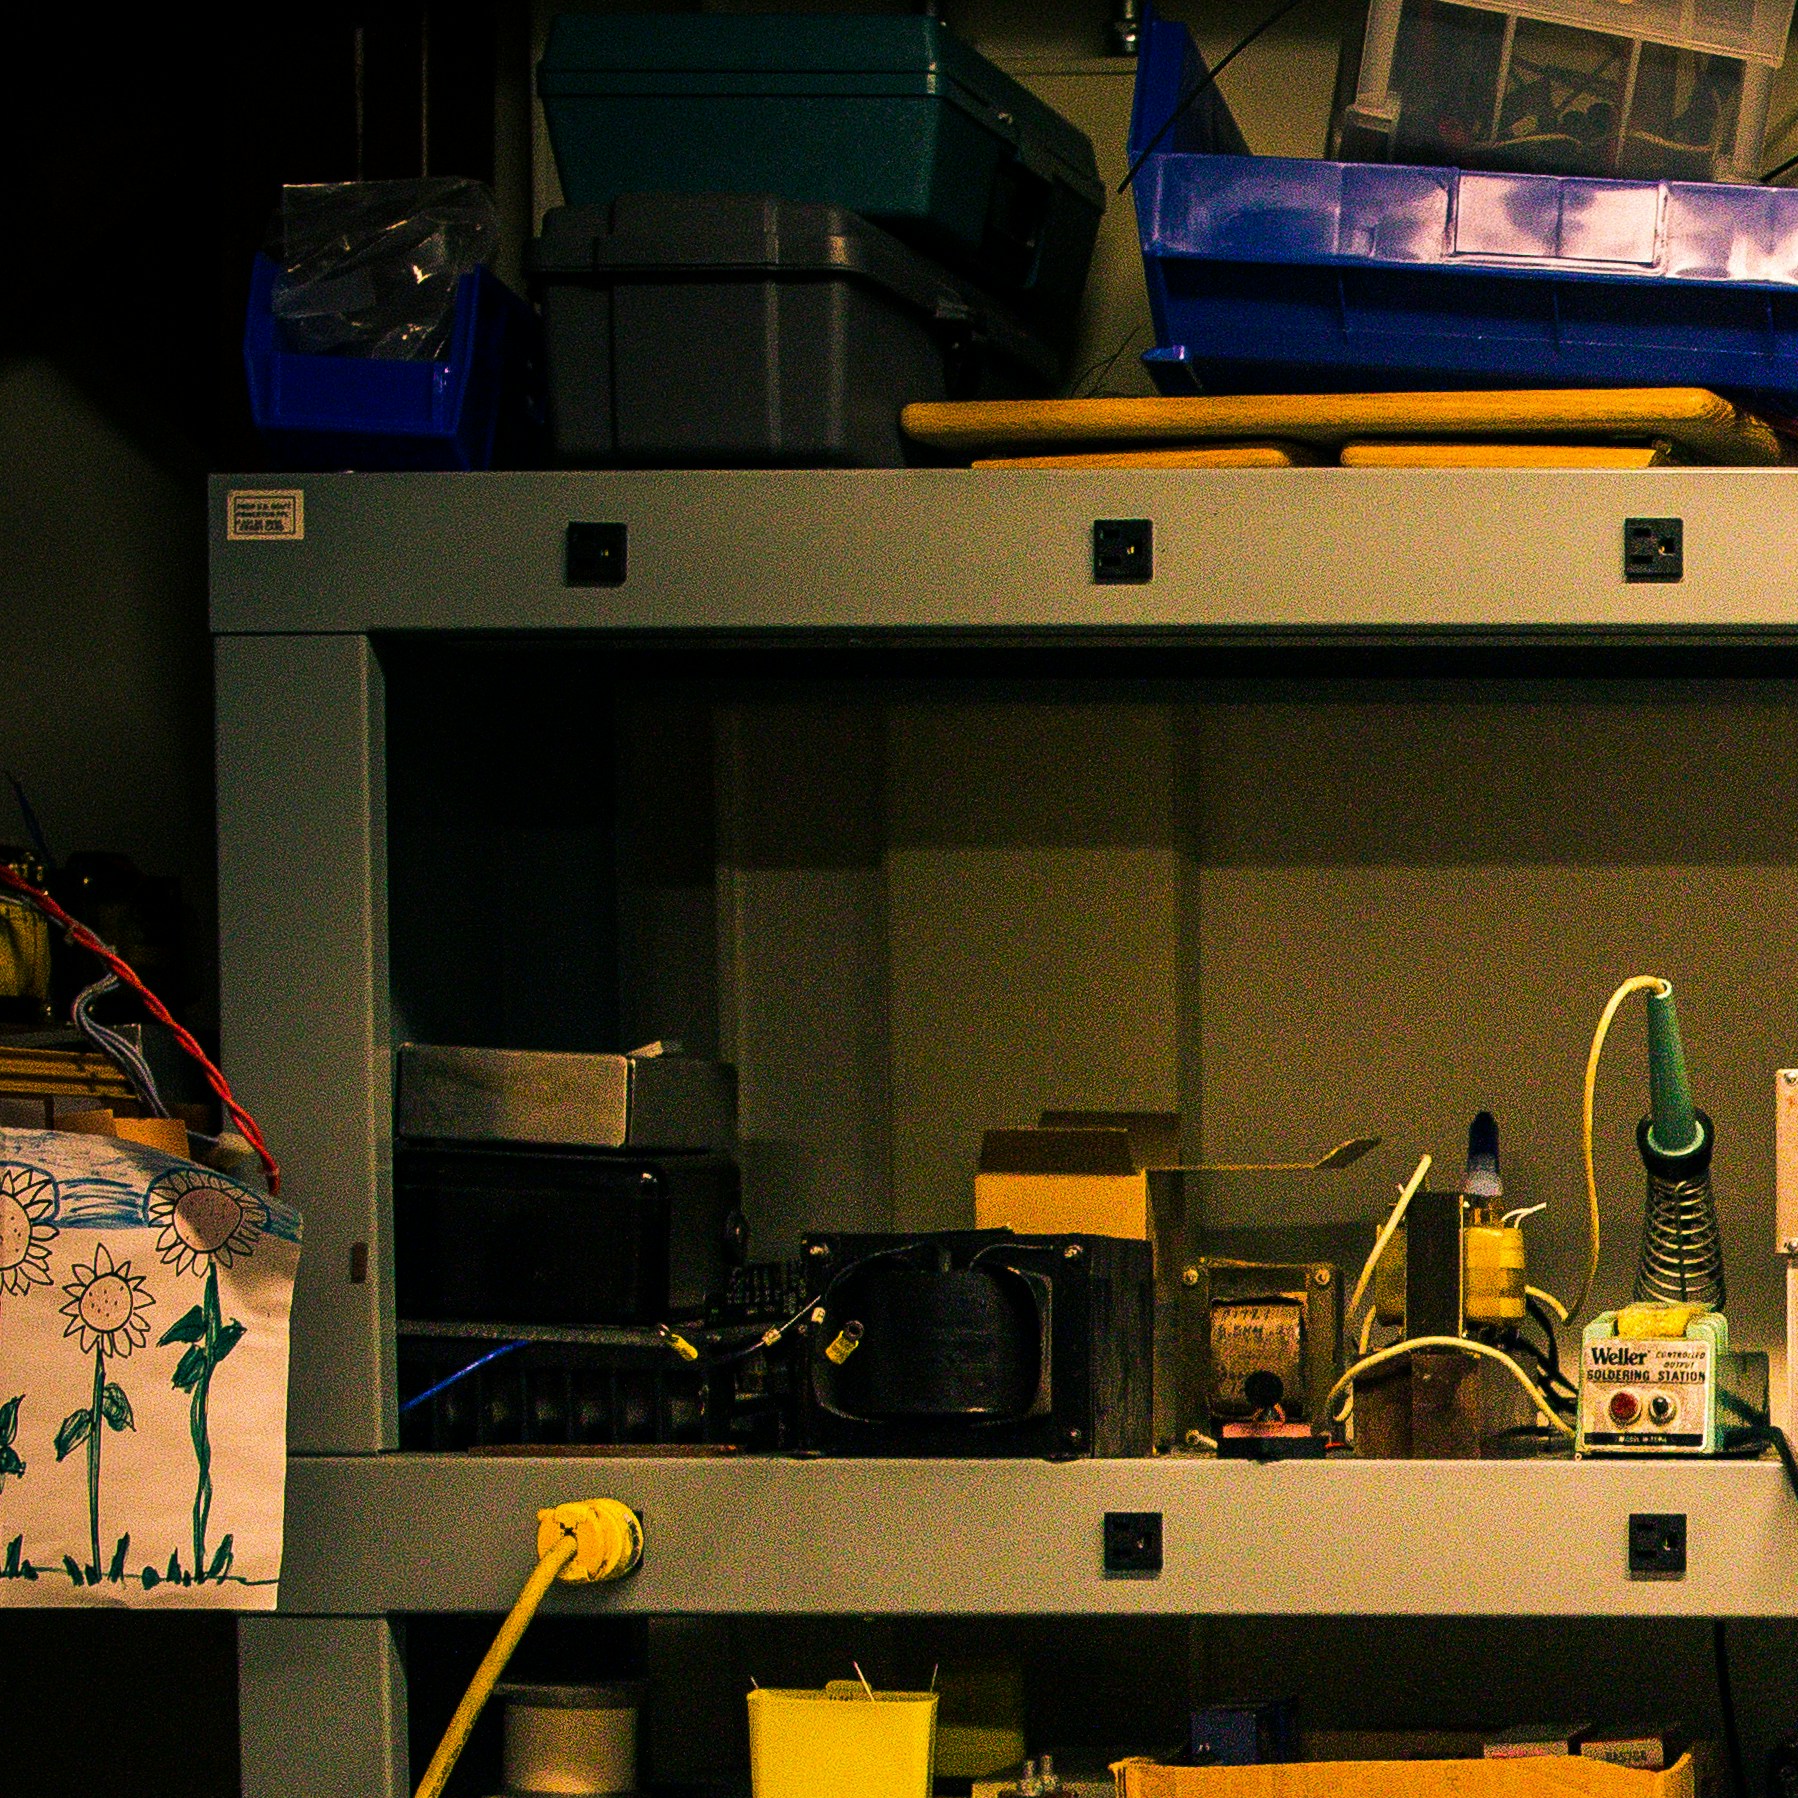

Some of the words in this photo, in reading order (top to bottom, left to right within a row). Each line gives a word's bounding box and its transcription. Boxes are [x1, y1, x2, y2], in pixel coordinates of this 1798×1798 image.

[1591, 1347, 1648, 1366] Weller
[1586, 1369, 1651, 1382] SOLDERING
[1657, 1371, 1706, 1382] STATION
